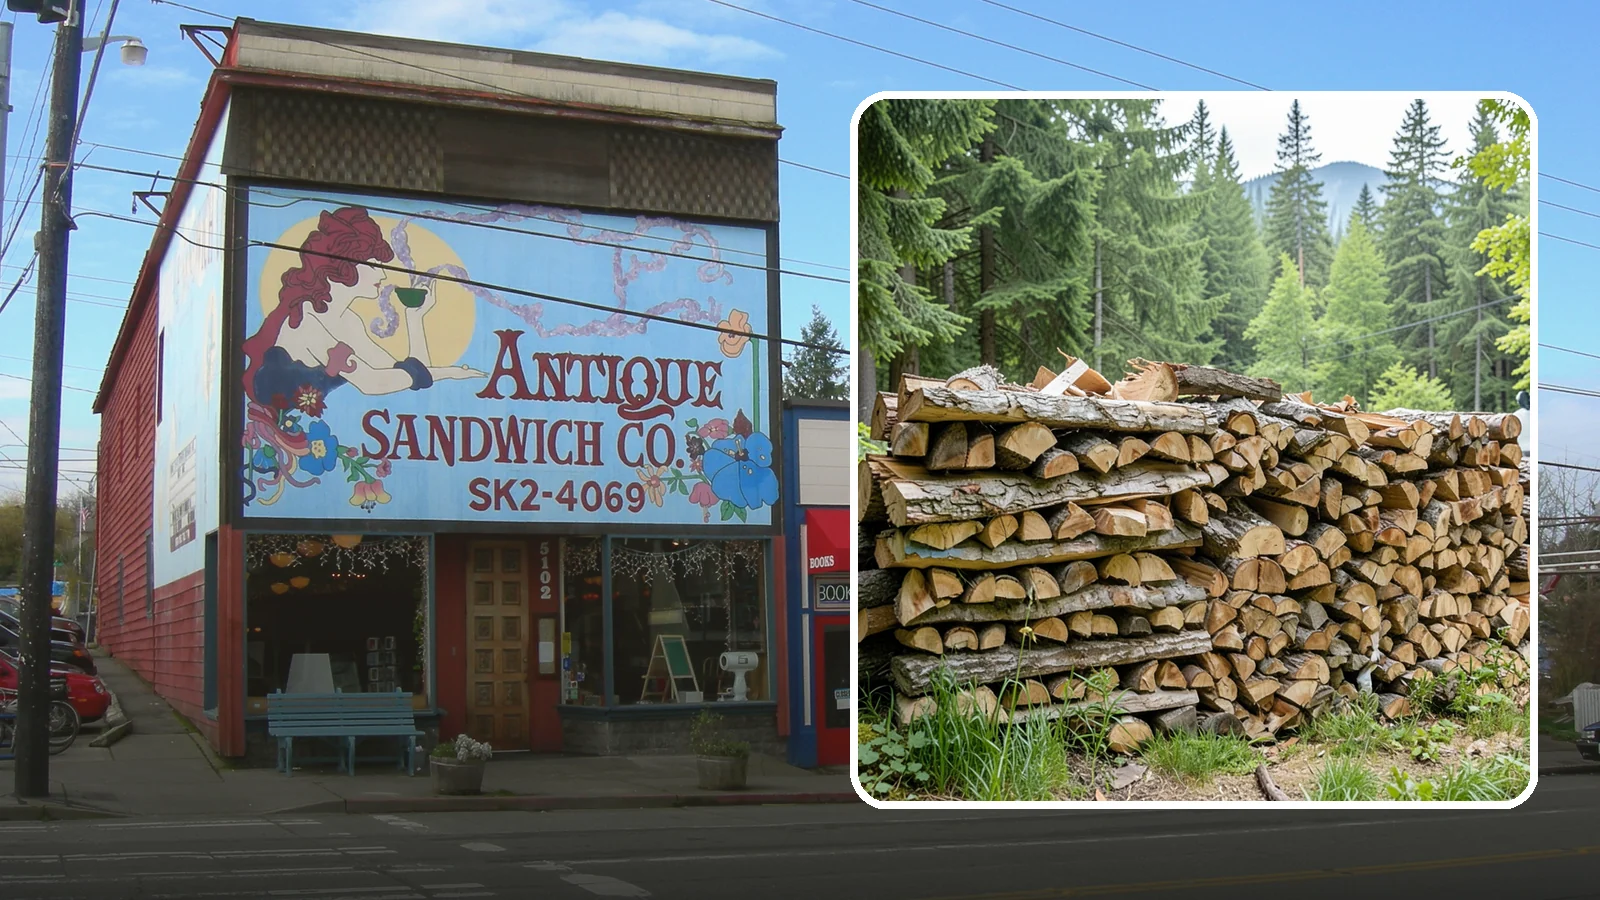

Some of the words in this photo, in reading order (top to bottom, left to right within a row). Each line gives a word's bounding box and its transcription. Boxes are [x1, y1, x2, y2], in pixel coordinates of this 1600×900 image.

[475, 329, 724, 421] ANTIQUE
[361, 408, 605, 467] SANDWICH
[617, 422, 684, 469] CO.
[468, 477, 645, 513] SK2-4069
[539, 541, 551, 600] 5102
[809, 555, 835, 569] BOOKS
